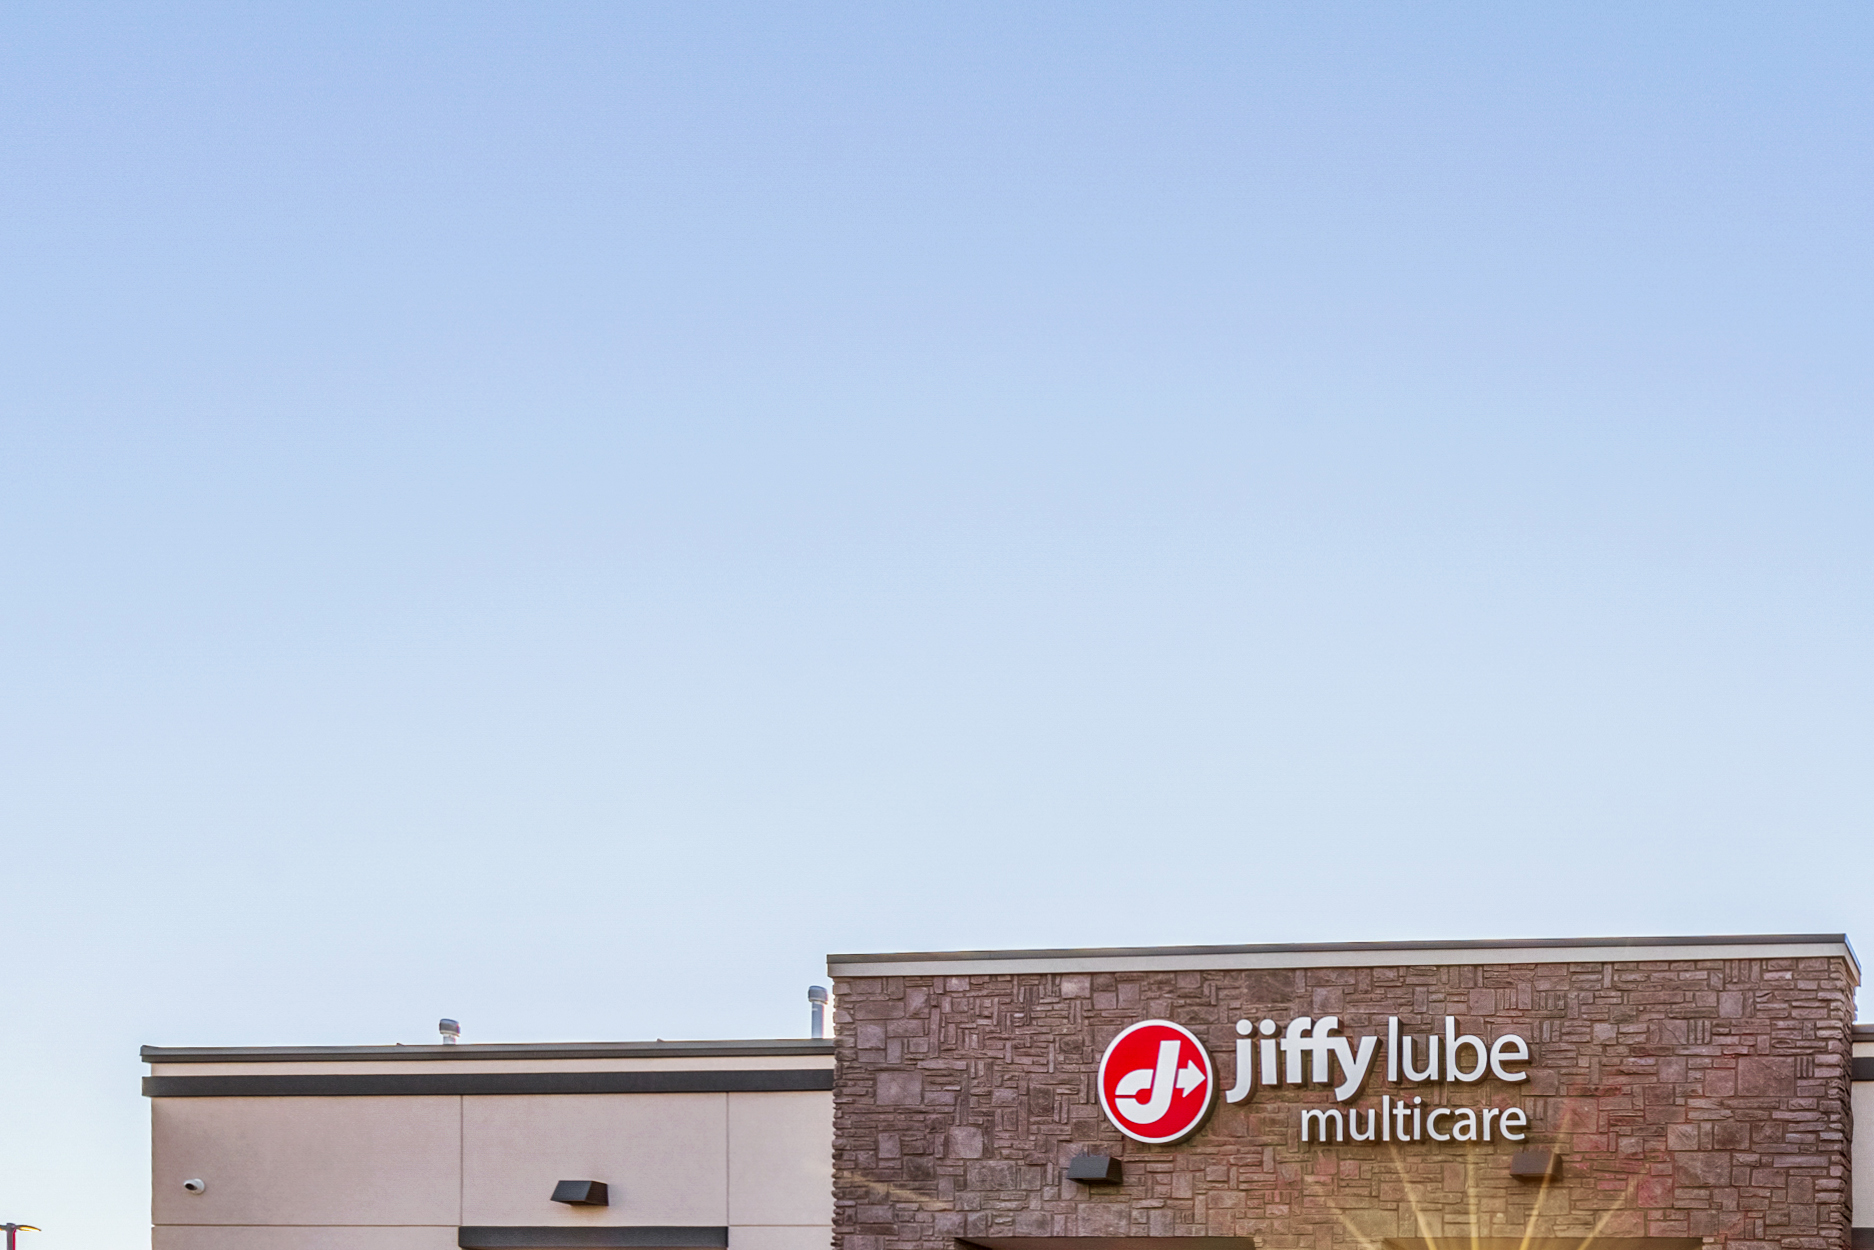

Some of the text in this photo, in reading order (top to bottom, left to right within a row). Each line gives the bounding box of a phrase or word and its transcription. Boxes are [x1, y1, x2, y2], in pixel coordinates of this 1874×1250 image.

[1226, 1016, 1529, 1104] jiffy lube
[1301, 1095, 1528, 1142] multicare
